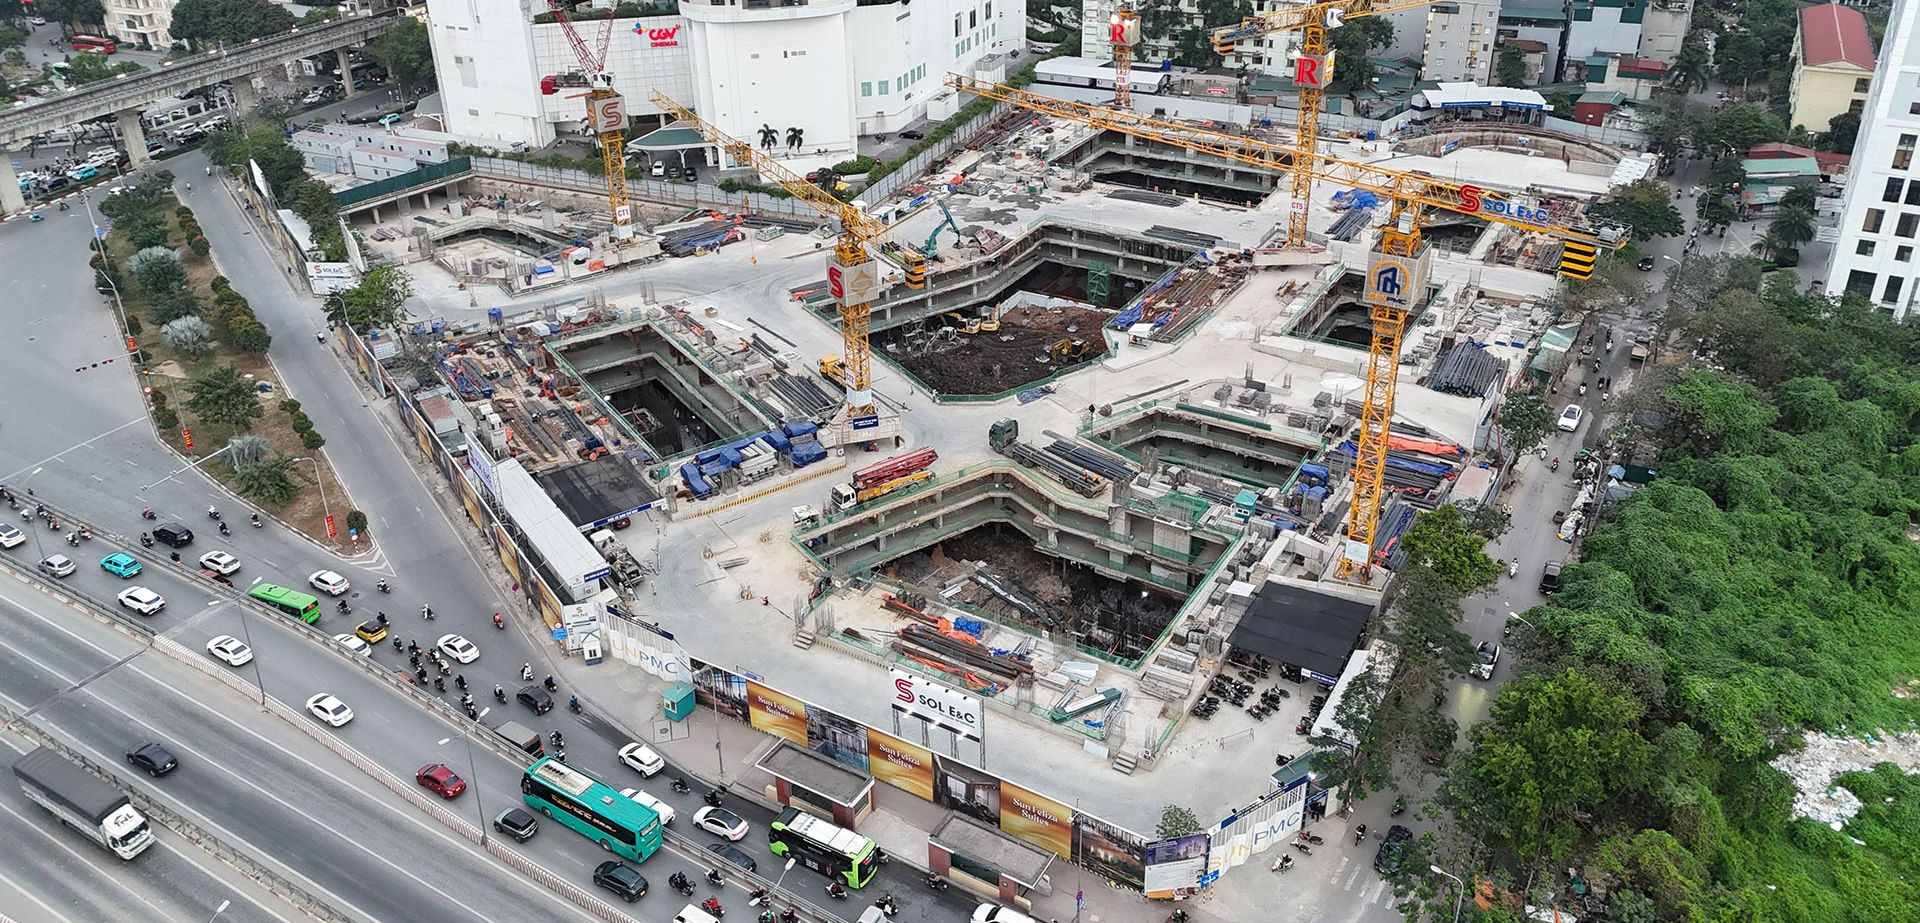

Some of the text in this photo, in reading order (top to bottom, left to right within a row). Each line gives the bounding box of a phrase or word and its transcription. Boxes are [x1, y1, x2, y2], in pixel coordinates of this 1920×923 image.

[649, 27, 677, 41] CGV
[1294, 57, 1320, 85] R
[1483, 198, 1513, 215] SOL
[1517, 204, 1548, 222] E&C
[757, 695, 773, 707] Sun
[919, 694, 945, 713] SOL
[948, 705, 975, 724] E&C
[765, 705, 790, 721] Suites
[879, 742, 896, 756] Sun
[887, 753, 913, 770] Suites
[1012, 797, 1058, 823] Sun Feliza
[1021, 809, 1050, 827] Suites
